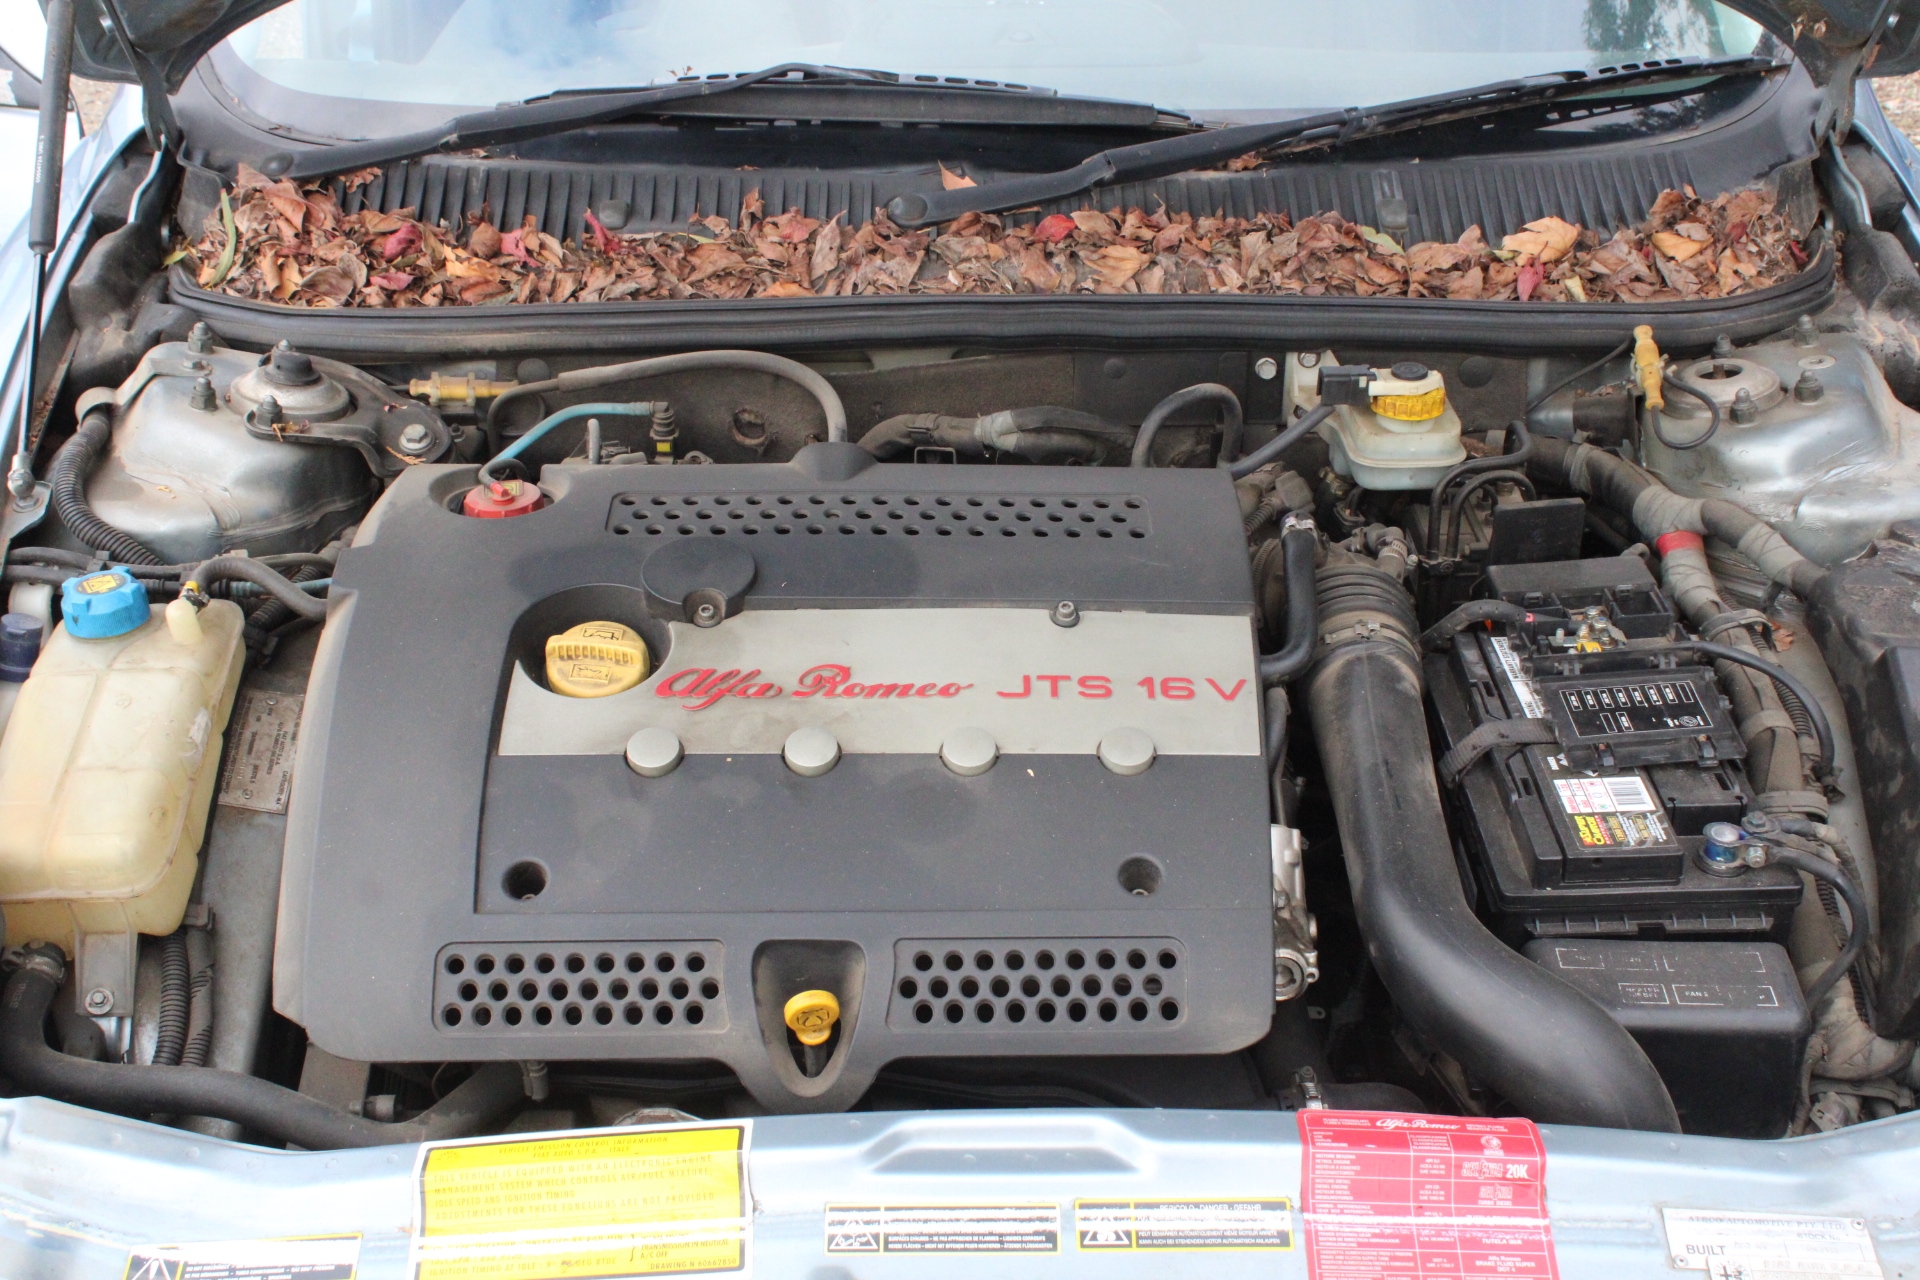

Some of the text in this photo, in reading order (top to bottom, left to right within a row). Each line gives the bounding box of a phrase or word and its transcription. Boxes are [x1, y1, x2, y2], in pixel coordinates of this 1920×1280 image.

[655, 664, 973, 711] Alfa Romeo
[997, 675, 1112, 700] JTS
[276, 721, 284, 733] ALFA
[271, 733, 282, 750] ROMEO
[278, 741, 287, 753] AUTO
[1574, 815, 1593, 838] SUPER
[1585, 815, 1605, 845] CHARGE
[1685, 990, 1702, 998] FAN
[1376, 1118, 1461, 1130] Alfa Romeo
[499, 1137, 668, 1155] VEHICLE EMISSION CONTROL INFORMATION
[533, 1151, 549, 1160] FIAT
[553, 1149, 573, 1158] AUTO
[609, 1146, 630, 1154] ITALY
[434, 1154, 713, 1184] THIS VEHICLE IS EQUIPPED WITH AN ELECTRONIC ENGINE
[1506, 1164, 1529, 1179] 20K
[434, 1182, 495, 1196] MANAGEMENT
[499, 1180, 532, 1191] SYSTEM
[537, 1178, 567, 1188] WHICH
[571, 1174, 617, 1186] CONTROLS
[621, 1170, 664, 1181] AIR/FUEL
[435, 1190, 576, 1209] IDLE SPEED AND IGNITION TIMING
[435, 1192, 715, 1221] ADJUSTMENTS FOR THESE FUNCTIONS ARE NOT PROVIDED
[1233, 1203, 1262, 1211] GEFAHR
[1725, 1217, 1792, 1228] AUTOMOTIVE
[1796, 1220, 1815, 1229] PTY
[1482, 1237, 1507, 1245] TUTELA
[1797, 1232, 1826, 1240] STOCK
[641, 1239, 729, 1252] TRANSMISSION IN NEUTRAL
[1685, 1243, 1726, 1256] BUILT
[640, 1251, 670, 1261] A/C OFF
[429, 1267, 468, 1278] IGNITION
[471, 1264, 502, 1275] TIMING
[504, 1263, 515, 1272] AT
[517, 1262, 537, 1271] IDLE
[650, 1257, 738, 1271] DRAWING N 60662850
